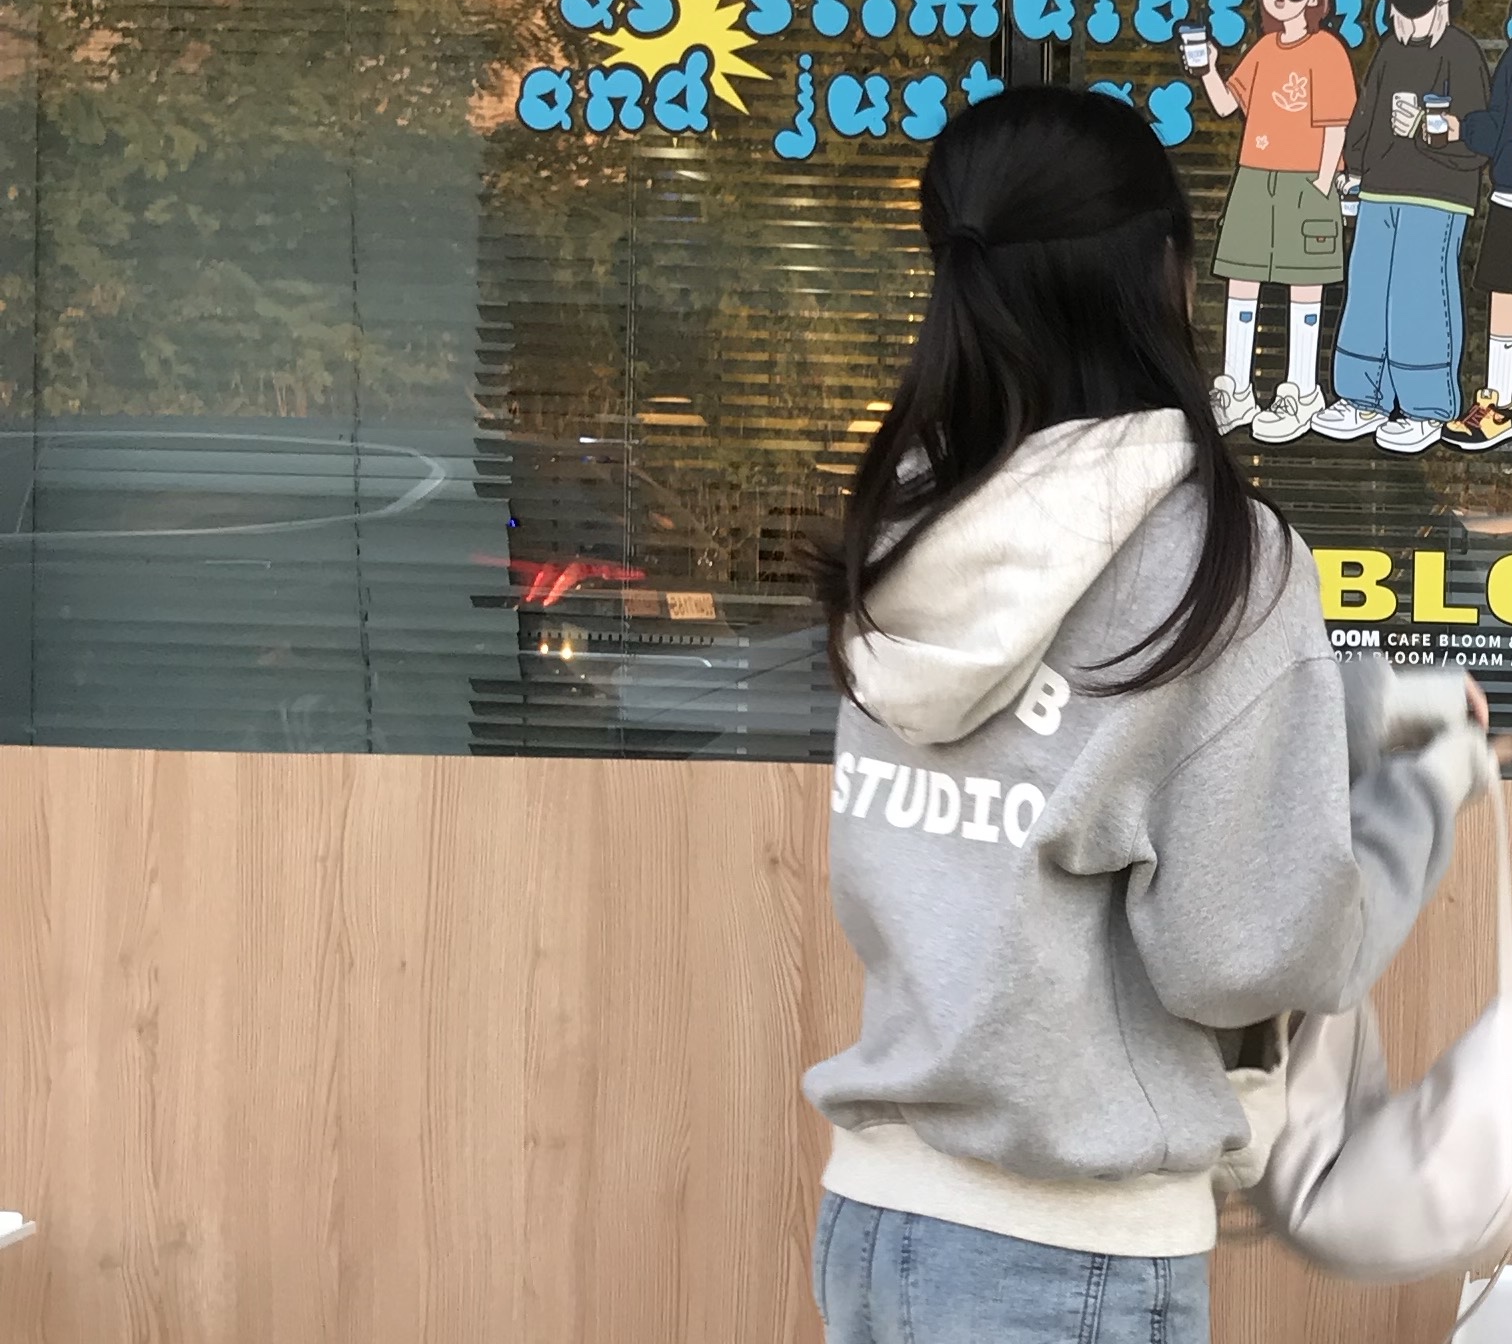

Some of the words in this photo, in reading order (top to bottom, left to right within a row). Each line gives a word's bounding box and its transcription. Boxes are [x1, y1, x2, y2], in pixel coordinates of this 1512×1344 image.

[517, 47, 712, 133] and
[1088, 79, 1194, 149] s
[1387, 633, 1432, 647] CAFE
[1439, 634, 1501, 649] BLOOM
[1441, 654, 1449, 668] /
[1455, 653, 1503, 667] OJAM
[832, 751, 1046, 848] STUDIO
